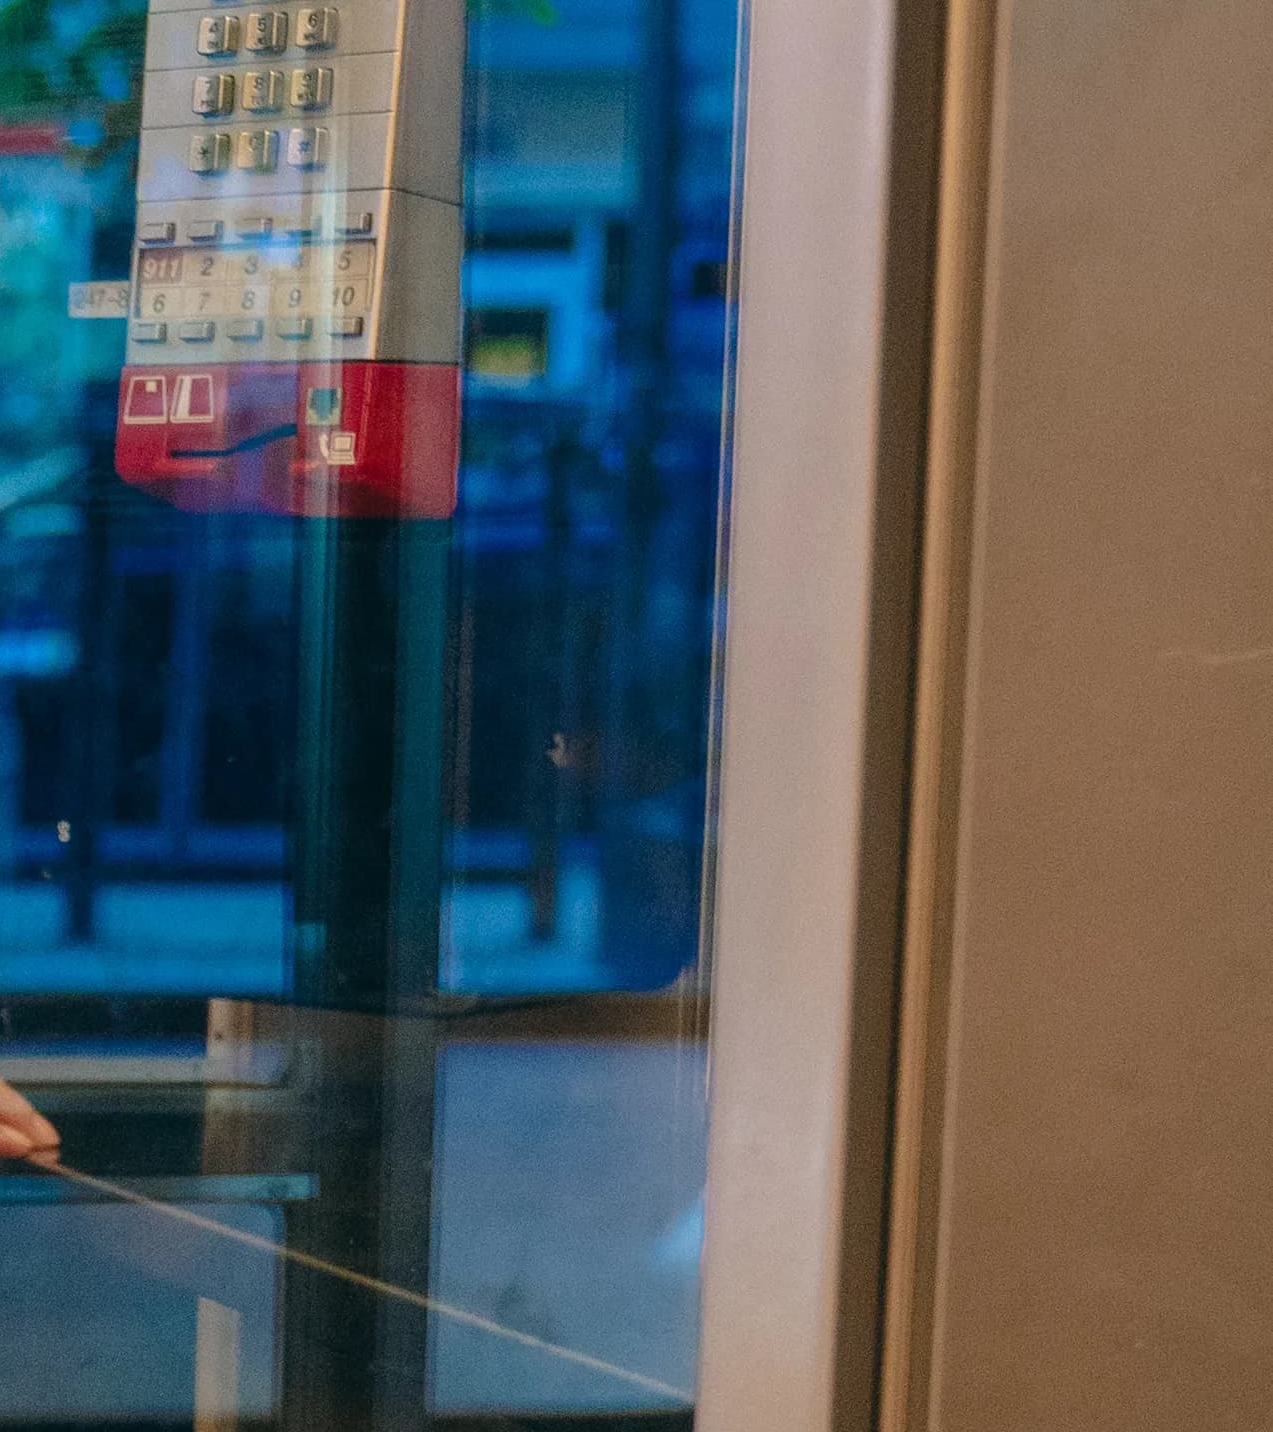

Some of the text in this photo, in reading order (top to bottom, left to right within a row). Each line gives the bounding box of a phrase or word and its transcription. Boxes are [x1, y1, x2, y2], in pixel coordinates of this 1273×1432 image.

[142, 258, 181, 279] 911
[200, 256, 215, 277] 2
[245, 255, 259, 275] 3
[338, 250, 351, 271] 5
[153, 293, 166, 313] 6
[241, 291, 255, 310] 8
[288, 288, 302, 308] 9
[332, 286, 356, 307] 10
